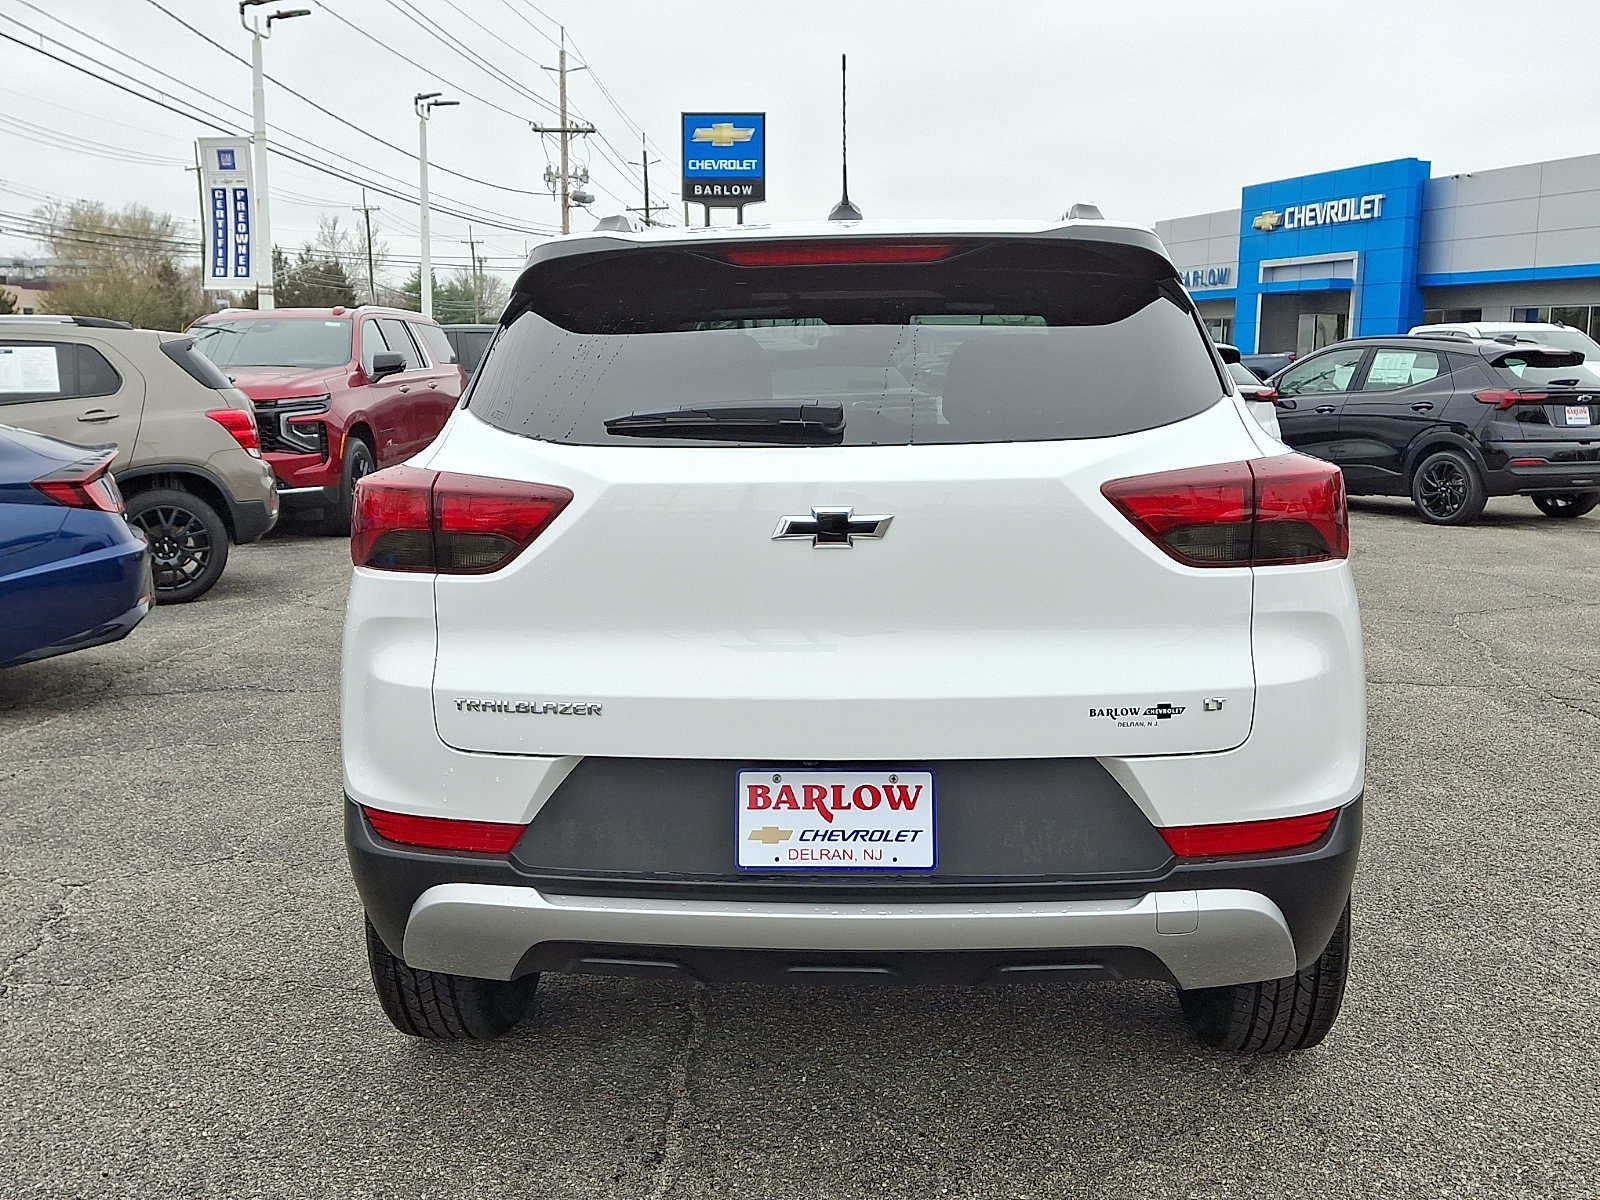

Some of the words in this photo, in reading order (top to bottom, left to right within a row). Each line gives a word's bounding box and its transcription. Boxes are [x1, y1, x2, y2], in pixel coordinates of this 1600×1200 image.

[688, 159, 758, 171] CHEVROLET
[694, 185, 753, 196] BARLOW
[1284, 193, 1386, 229] CHEVROLET
[214, 189, 225, 276] CERTIFIED
[235, 190, 248, 276] PREOWNED
[453, 698, 603, 716] TRAILBLAZER
[1203, 697, 1227, 711] LT
[1089, 707, 1140, 720] BARLOW
[747, 784, 923, 823] BARLOW
[799, 829, 923, 842] CHEVROLET
[788, 848, 858, 862] DELRAN,
[863, 848, 883, 861] NJ
